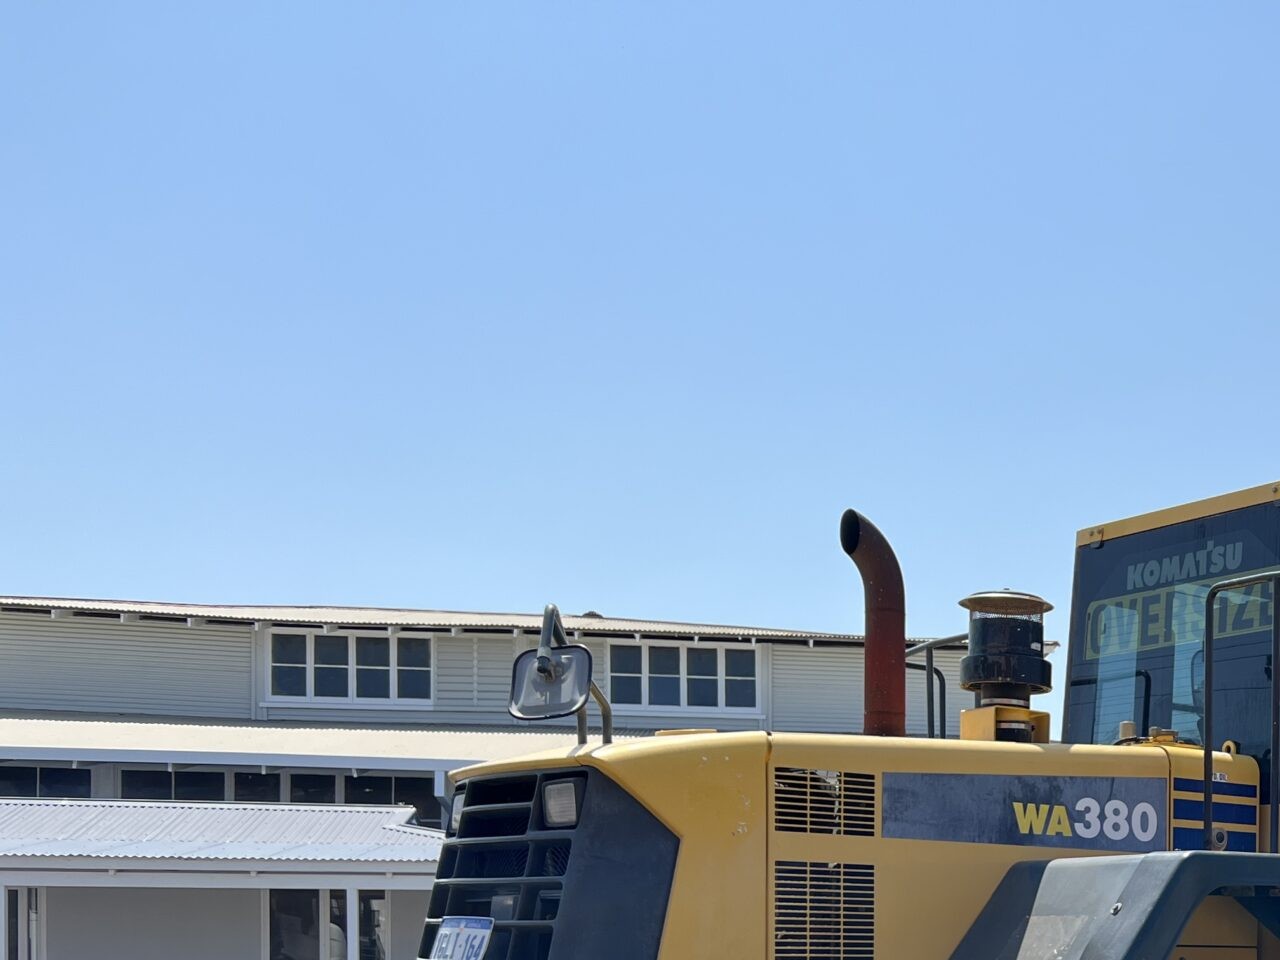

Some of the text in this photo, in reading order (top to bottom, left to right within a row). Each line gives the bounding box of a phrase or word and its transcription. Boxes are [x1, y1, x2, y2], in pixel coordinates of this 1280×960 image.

[1126, 541, 1243, 591] KOMATSU
[1090, 580, 1275, 655] OVERSIZE
[1012, 797, 1158, 842] WA380
